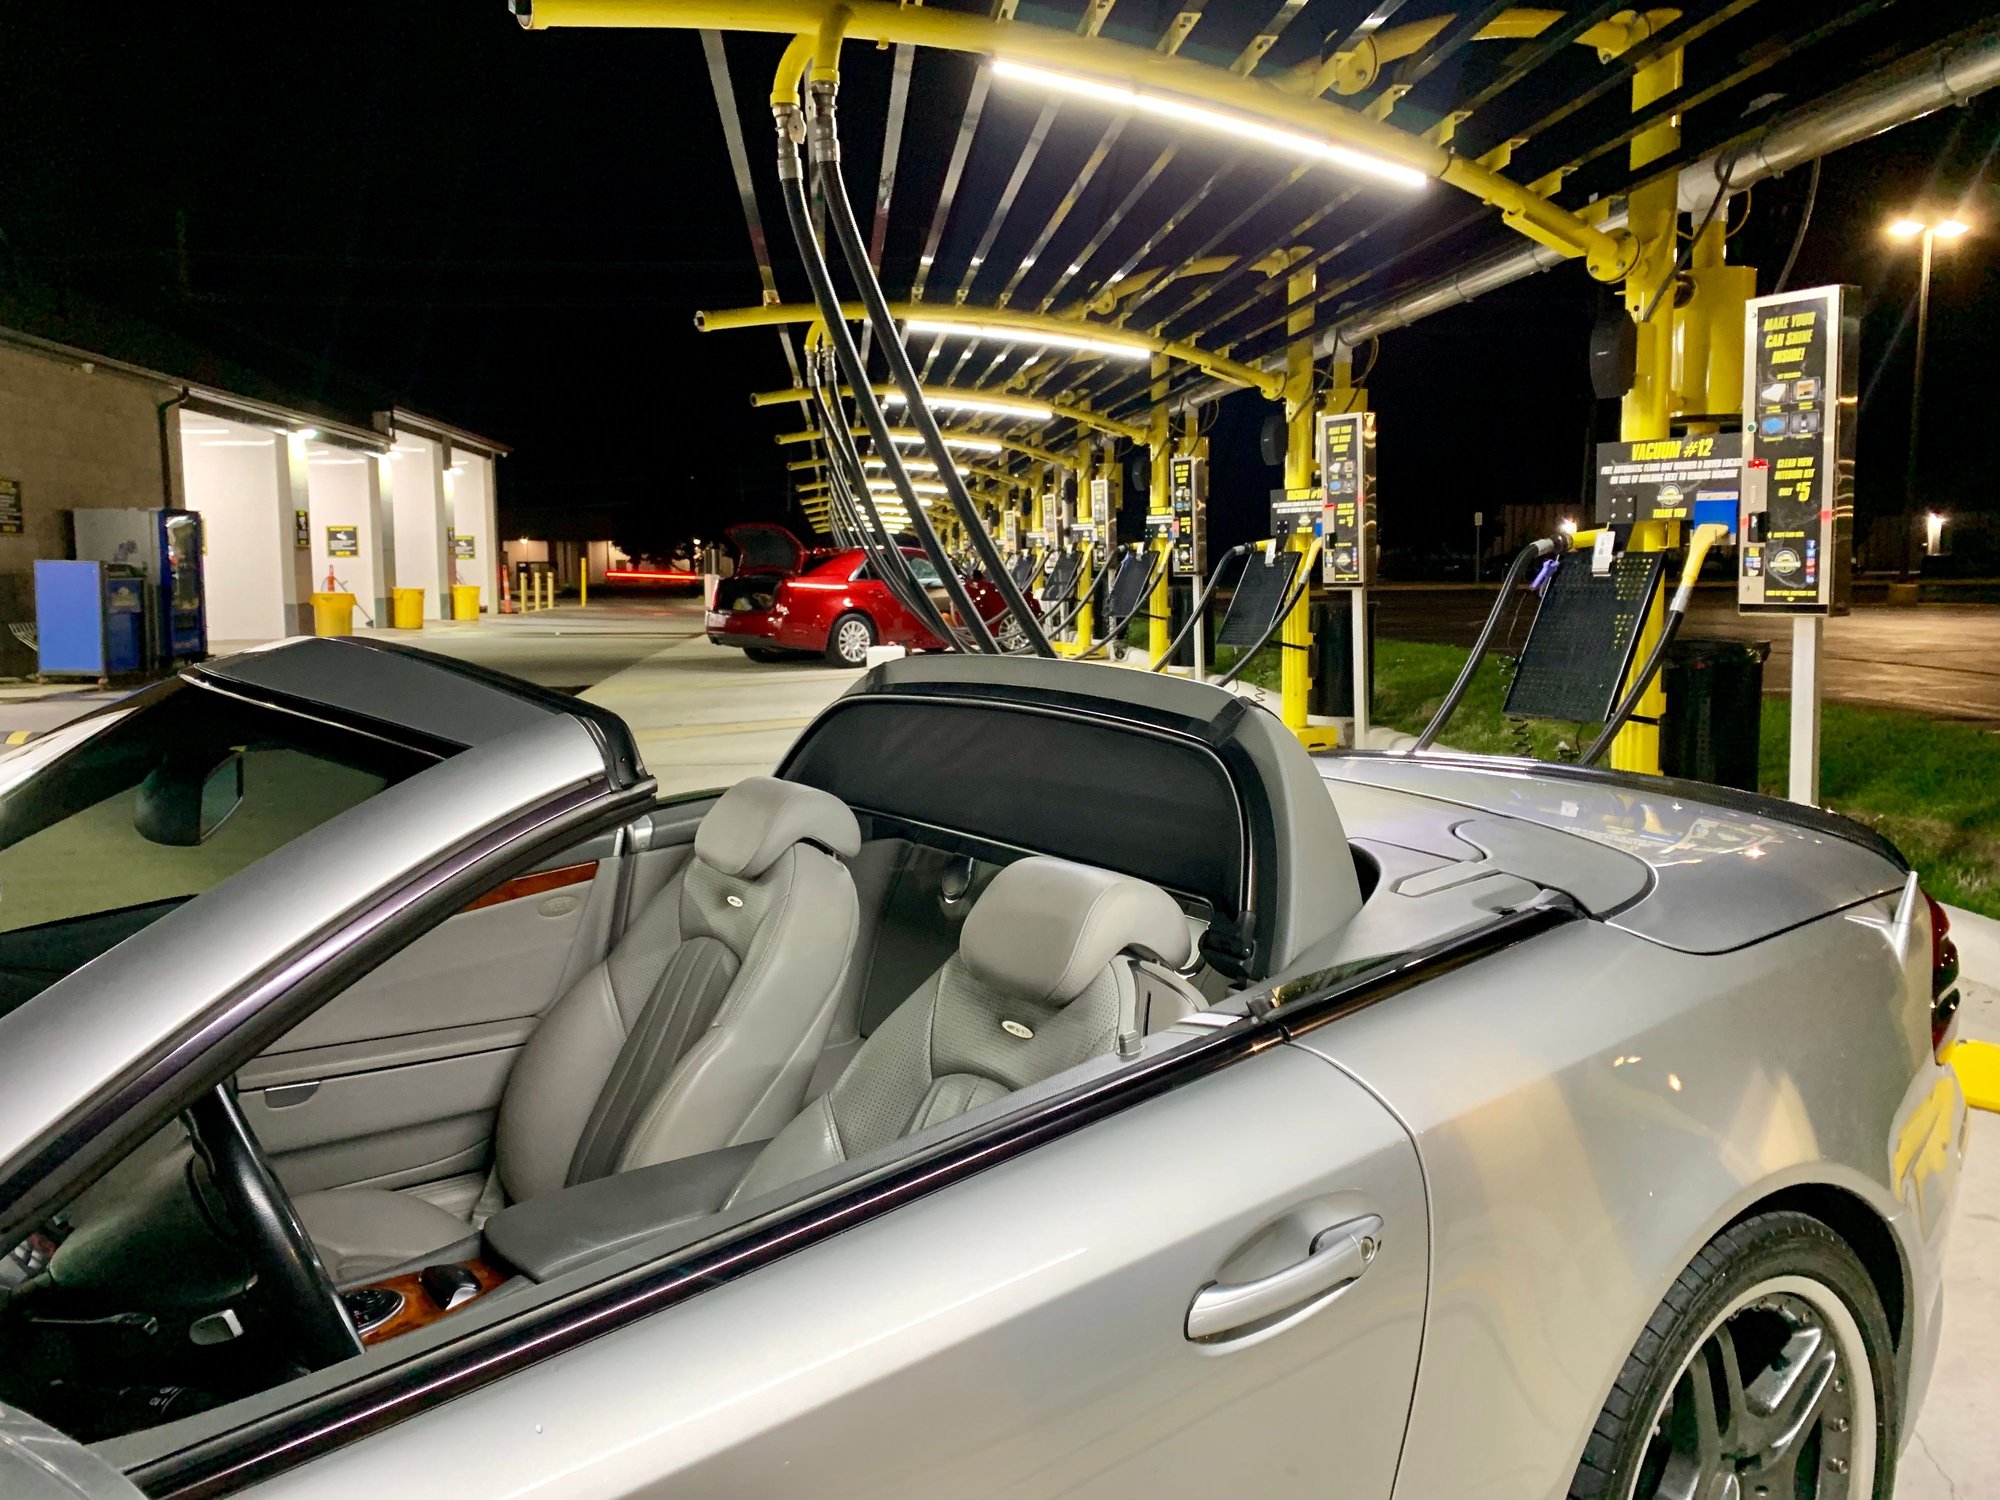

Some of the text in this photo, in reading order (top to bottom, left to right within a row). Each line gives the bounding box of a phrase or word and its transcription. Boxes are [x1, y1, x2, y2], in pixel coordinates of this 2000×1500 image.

[1763, 316, 1790, 332] MAKE
[1632, 437, 1714, 461] VACUUM #12
